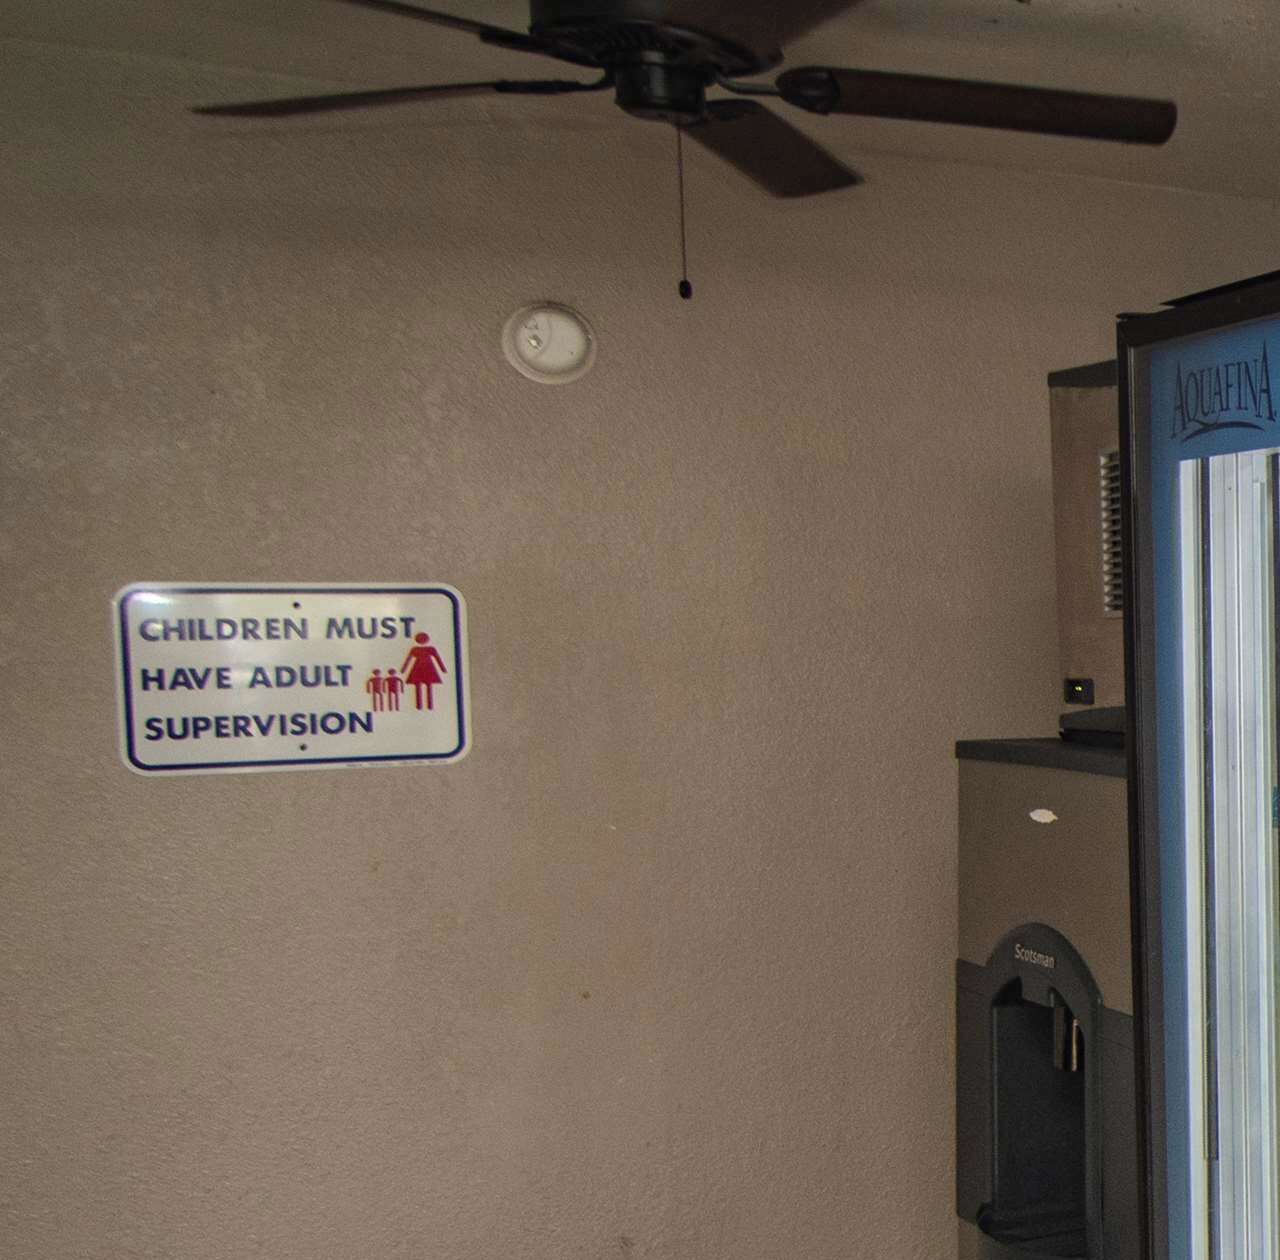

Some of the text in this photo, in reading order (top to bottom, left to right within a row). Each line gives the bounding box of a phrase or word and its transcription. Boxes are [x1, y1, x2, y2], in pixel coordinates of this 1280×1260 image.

[1171, 339, 1277, 440] AQUAFINA
[138, 617, 416, 642] CHILDREN MUST
[141, 664, 352, 691] HAVE ADULT
[144, 711, 373, 740] SUPERVISION
[1015, 944, 1055, 969] Scotsman
